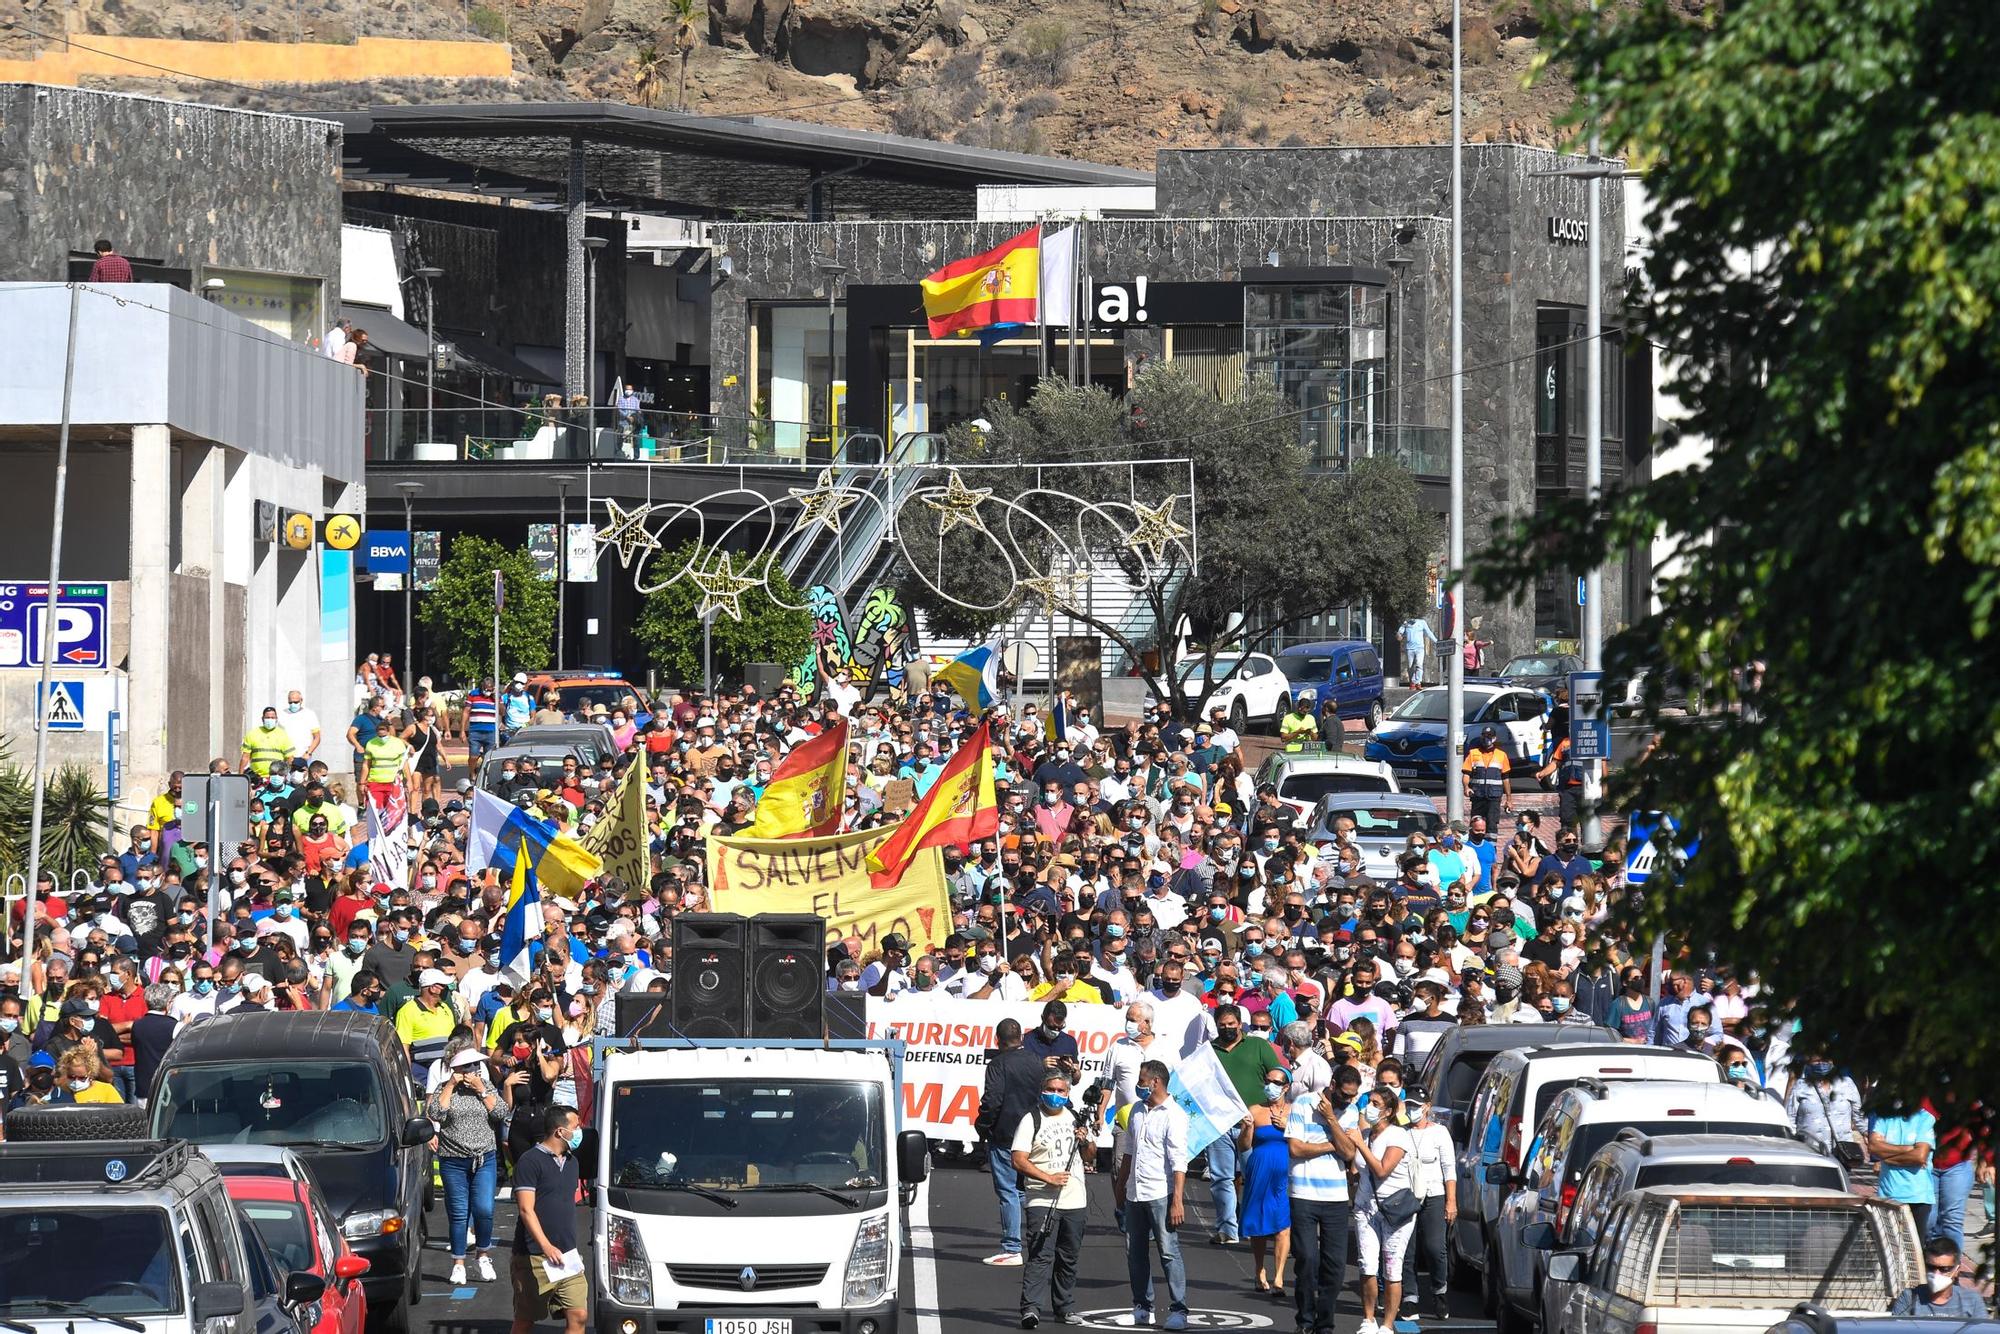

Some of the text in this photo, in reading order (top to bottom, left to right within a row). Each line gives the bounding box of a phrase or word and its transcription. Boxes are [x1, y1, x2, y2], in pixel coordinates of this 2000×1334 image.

[1552, 217, 1589, 242] LACOST
[1082, 275, 1148, 323] la!
[370, 546, 407, 557] BBVA
[37, 607, 93, 662] P
[812, 891, 855, 919] EL
[905, 1051, 962, 1065] DEFENSA
[1080, 1056, 1105, 1072] ÍSTI
[901, 1082, 981, 1126] MA
[718, 1321, 790, 1334] 1050 JSH
